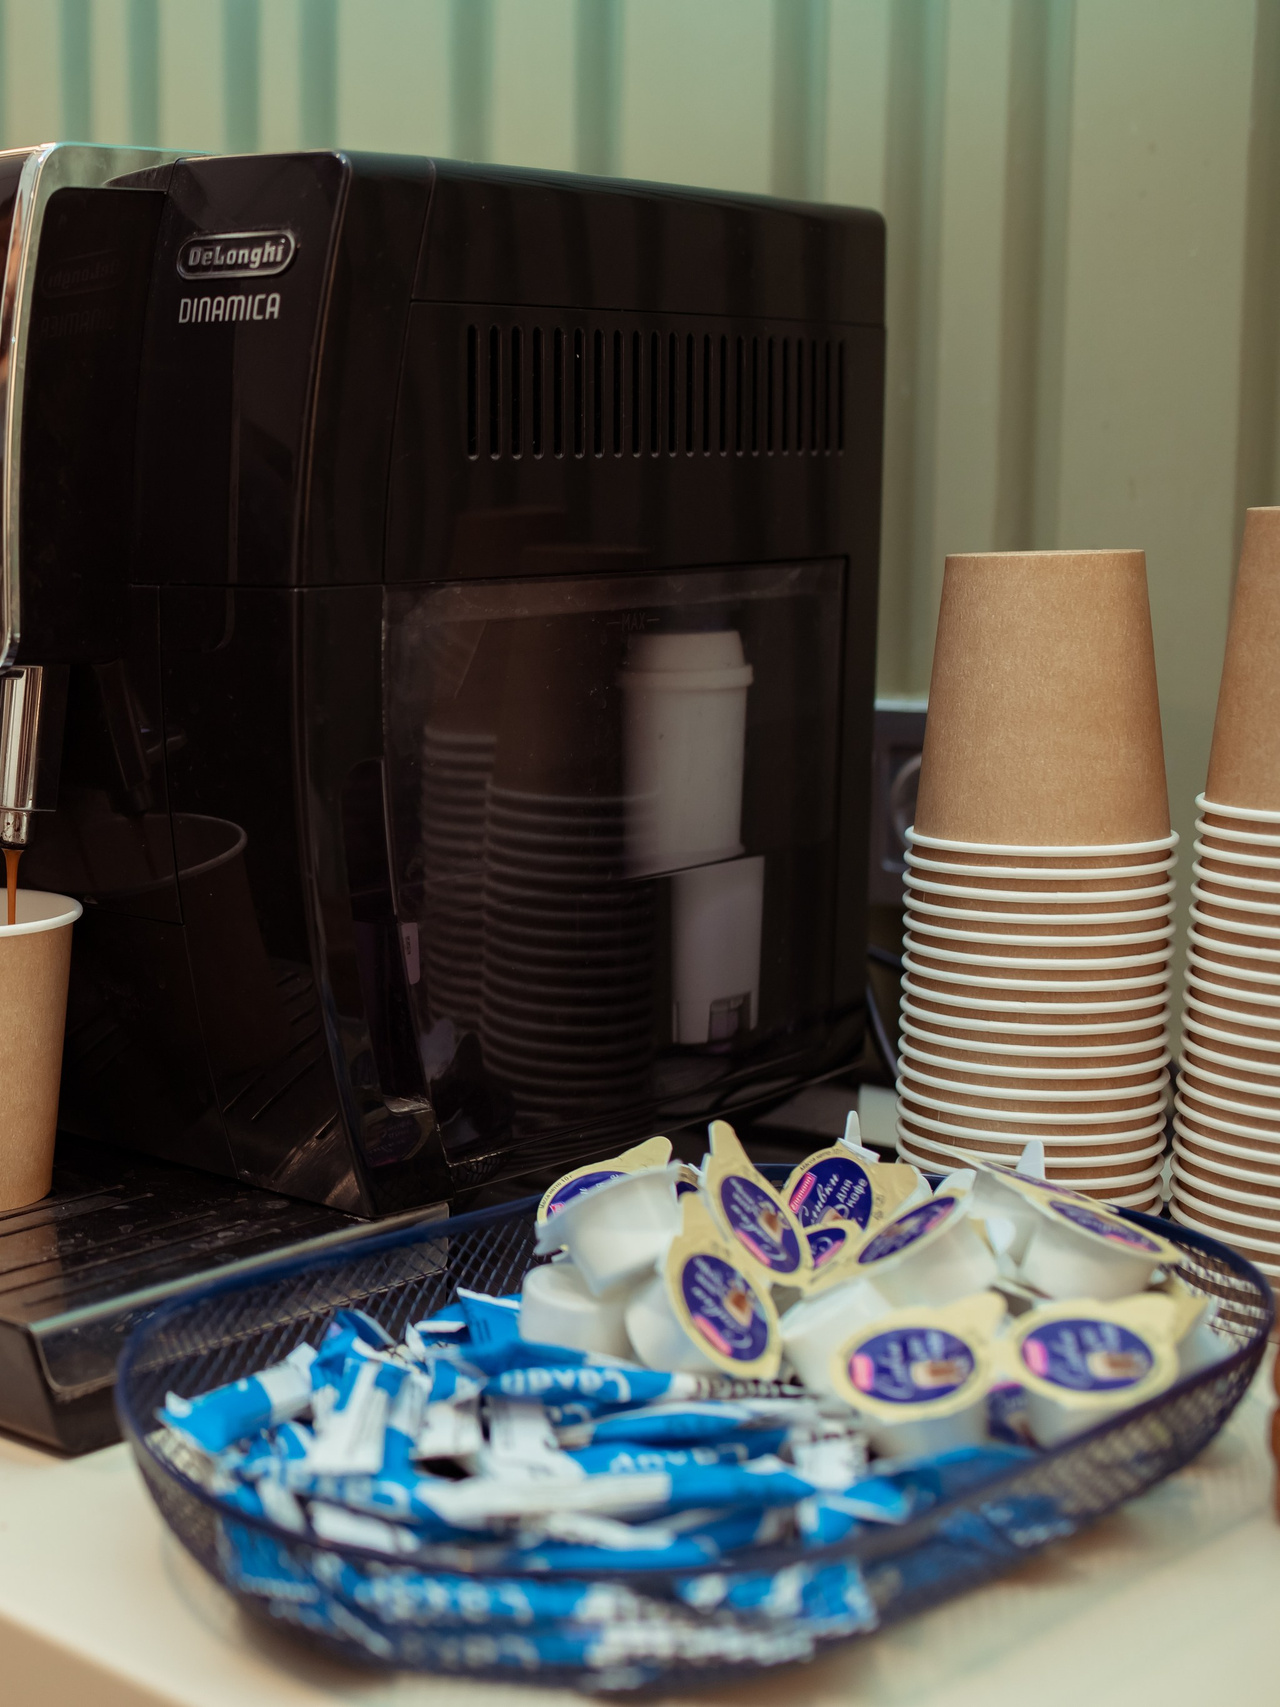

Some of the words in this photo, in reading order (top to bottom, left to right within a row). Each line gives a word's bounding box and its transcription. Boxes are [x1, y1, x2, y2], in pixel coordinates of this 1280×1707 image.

[179, 292, 281, 323] DINAMICA
[622, 613, 645, 632] MAX
[835, 1178, 854, 1204] для
[845, 1178, 869, 1209] кофе
